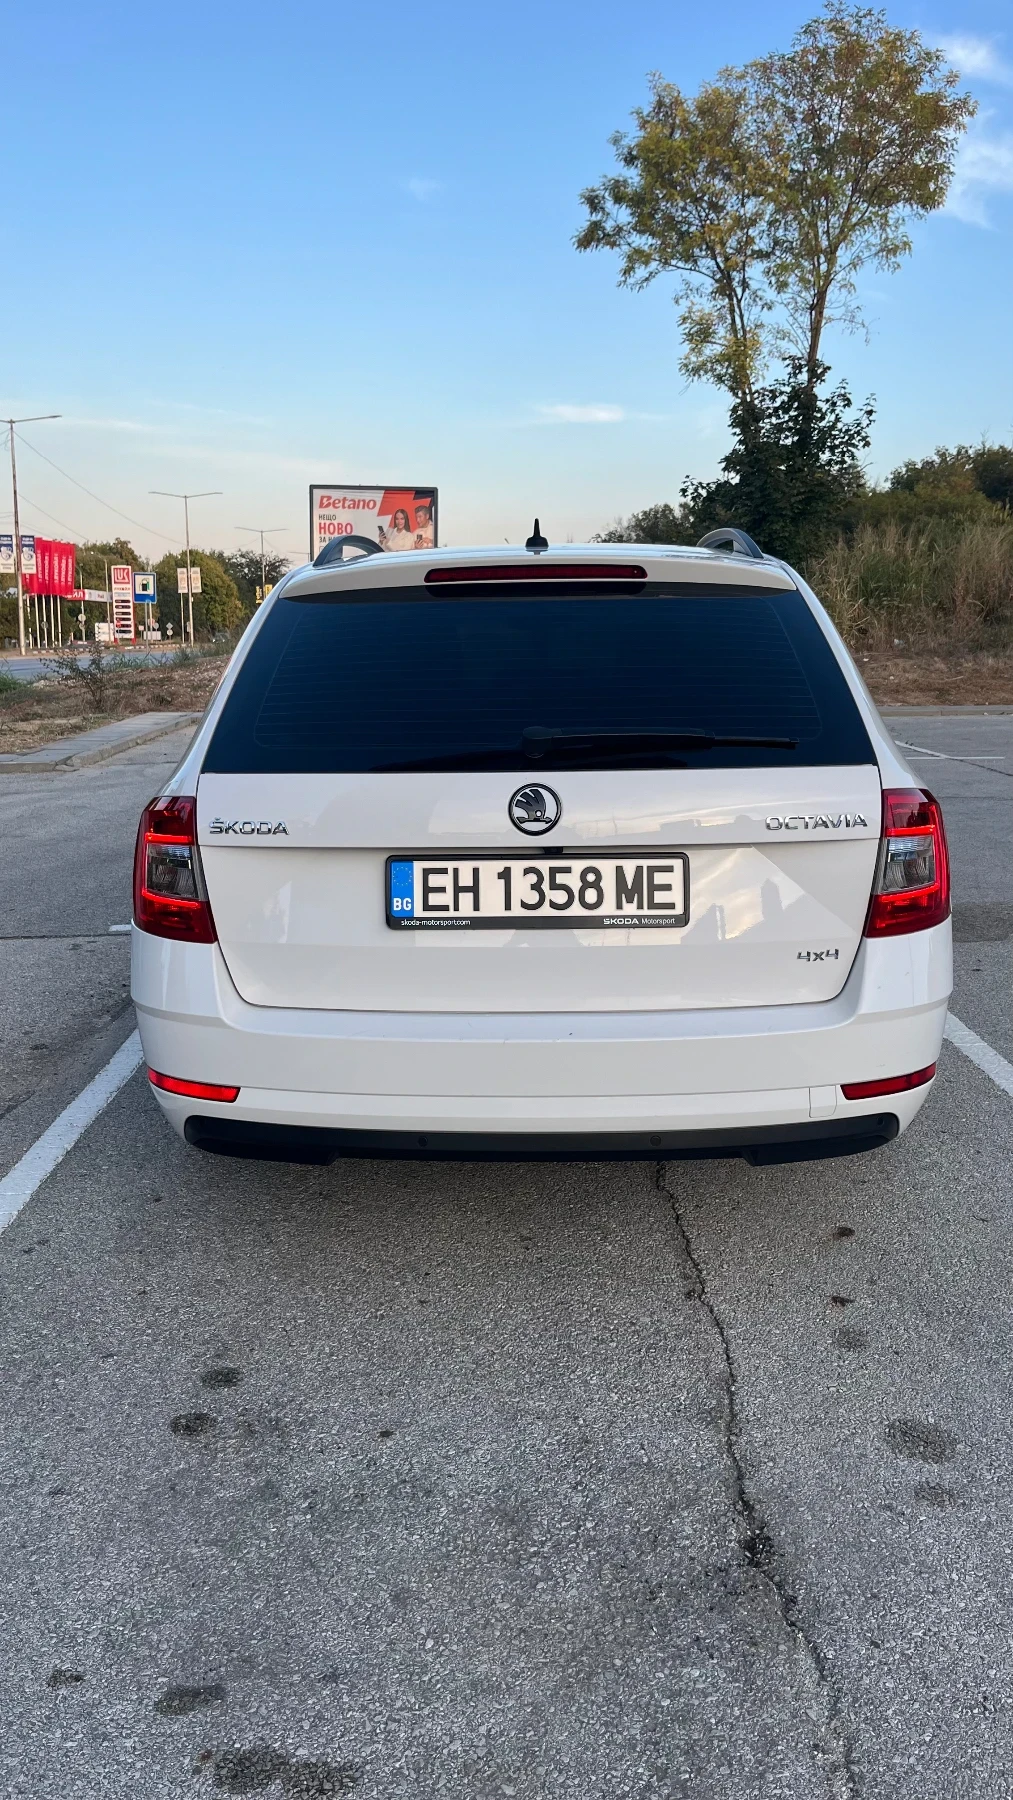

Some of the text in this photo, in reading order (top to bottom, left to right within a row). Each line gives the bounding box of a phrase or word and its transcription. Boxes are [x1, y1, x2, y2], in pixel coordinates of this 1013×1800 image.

[319, 496, 377, 510] Betano
[319, 522, 354, 535] НОВО
[209, 817, 289, 835] ŠKODA
[765, 813, 868, 831] OCTAVIA
[422, 864, 676, 912] EH 1358 ME
[393, 898, 412, 910] BG
[641, 917, 676, 926] Motorsport
[796, 948, 840, 962] 4x4
